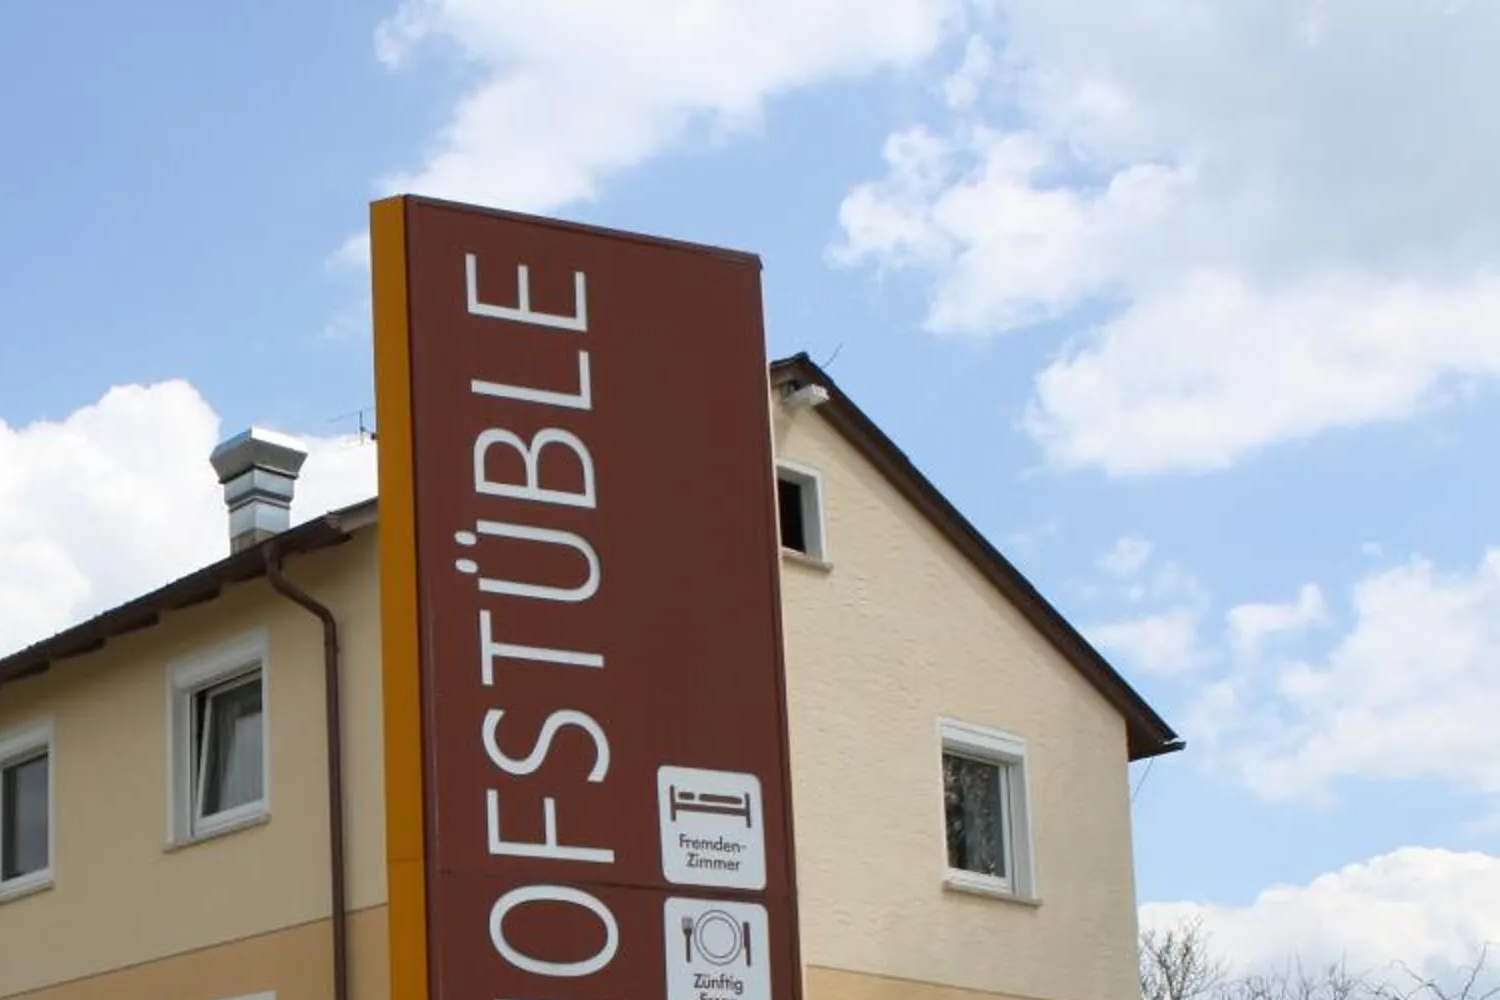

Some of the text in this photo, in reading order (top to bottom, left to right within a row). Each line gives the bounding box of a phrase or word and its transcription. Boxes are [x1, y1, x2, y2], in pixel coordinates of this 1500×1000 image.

[678, 833, 747, 853] Fremden-
[685, 852, 740, 872] Zimmer
[693, 973, 744, 995] Zünftig
